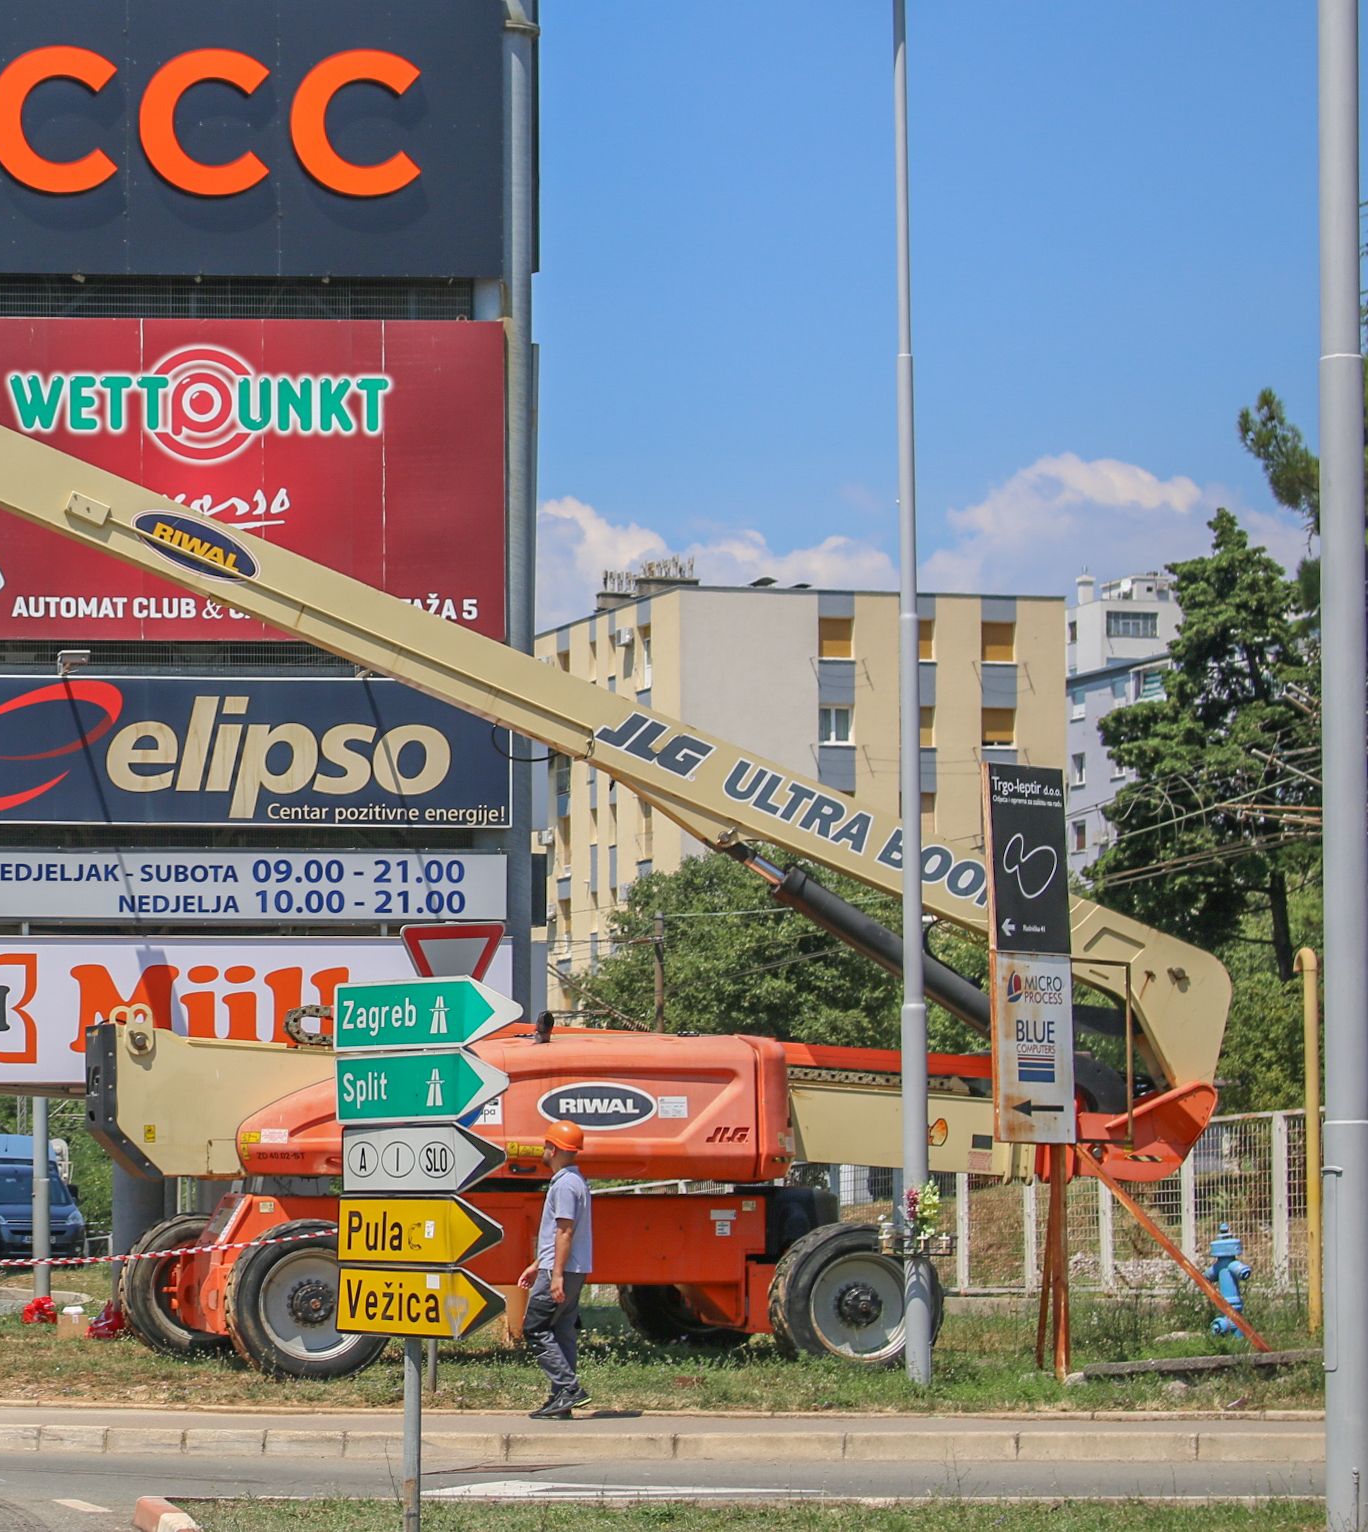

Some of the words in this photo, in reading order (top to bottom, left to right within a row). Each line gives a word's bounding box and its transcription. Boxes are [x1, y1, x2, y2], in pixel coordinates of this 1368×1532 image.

[152, 521, 240, 572] RIWAL
[11, 596, 128, 619] AUTOMAT
[132, 596, 197, 619] CLUB
[201, 599, 224, 619] &
[462, 599, 478, 620] 5
[106, 696, 451, 818] elipso
[991, 776, 1041, 797] Trgo-leptir
[1043, 785, 1062, 797] d.o.o.
[267, 803, 329, 820] Centar
[334, 803, 419, 823] pozitivne
[425, 804, 505, 826] energije!
[595, 712, 716, 778] JLG
[722, 758, 874, 856] ULTRA
[875, 827, 988, 908] BOO
[140, 863, 239, 883] SUBOTA
[252, 859, 344, 884] 09.00
[373, 859, 465, 884] 21.00
[118, 895, 240, 913] NEDJELJA
[255, 889, 345, 914] 10.00
[374, 890, 466, 914] 21.00
[1023, 975, 1063, 992] MICRO
[1023, 991, 1063, 1005] PROCESS
[342, 997, 417, 1036] Zagreb
[1015, 1019, 1055, 1044] BLUE
[1015, 1043, 1056, 1054] COMPUTERS
[343, 1070, 388, 1109] Split
[559, 1097, 640, 1114] RIWAL
[705, 1127, 750, 1143] JLG
[359, 1147, 367, 1171] A
[426, 1147, 448, 1172] SLO
[347, 1279, 440, 1323] Vežica
